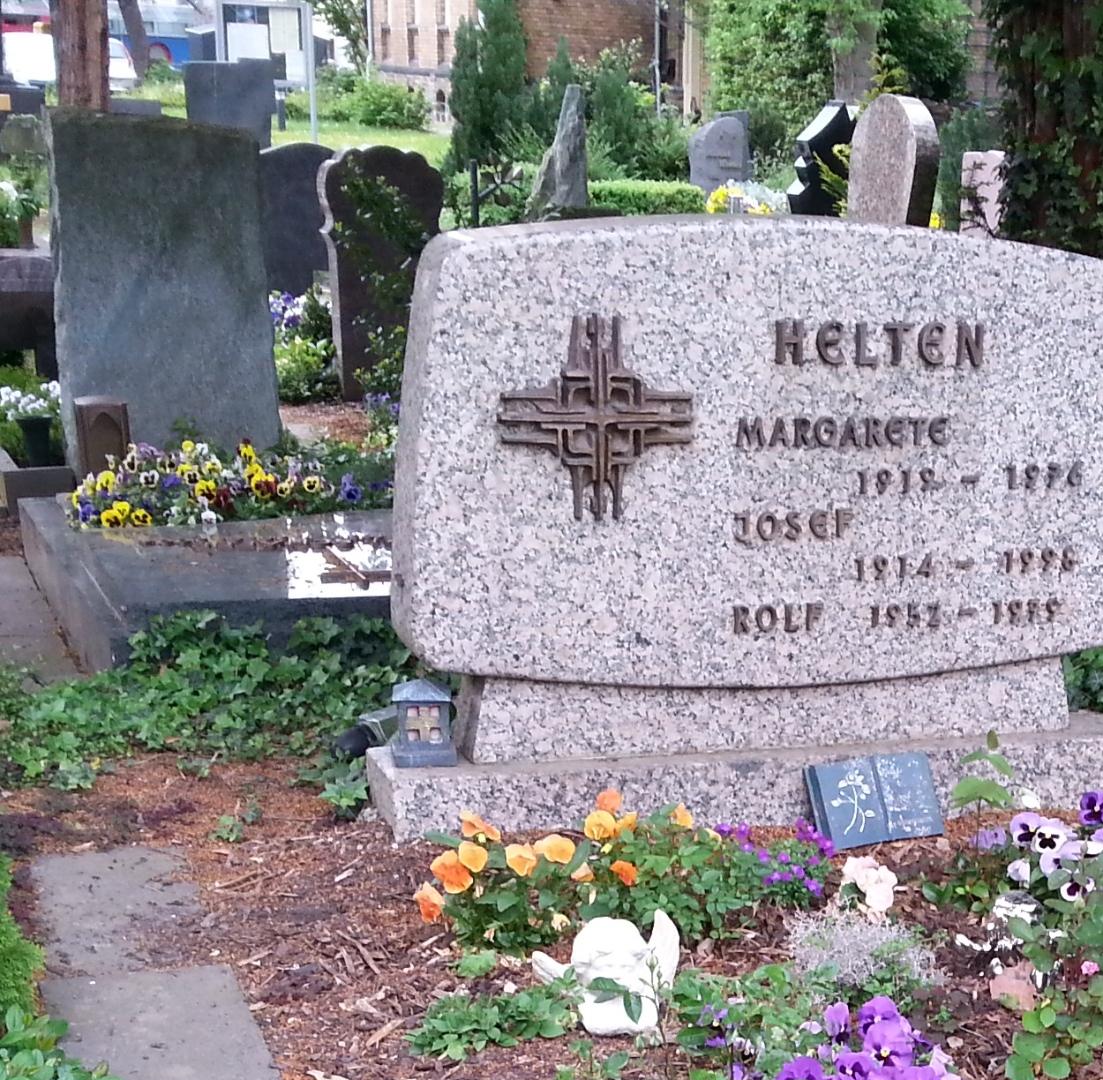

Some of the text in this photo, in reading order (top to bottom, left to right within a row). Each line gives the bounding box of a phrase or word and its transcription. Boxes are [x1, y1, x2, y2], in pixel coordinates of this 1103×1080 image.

[773, 318, 986, 367] HELTEN
[735, 415, 950, 448] MARGARETE
[1005, 460, 1084, 490] 1976
[733, 508, 854, 545] JOSEF
[854, 552, 935, 581] 1914
[1003, 546, 1075, 574] 1998
[733, 602, 825, 635] ROLF
[870, 601, 941, 628] 1952
